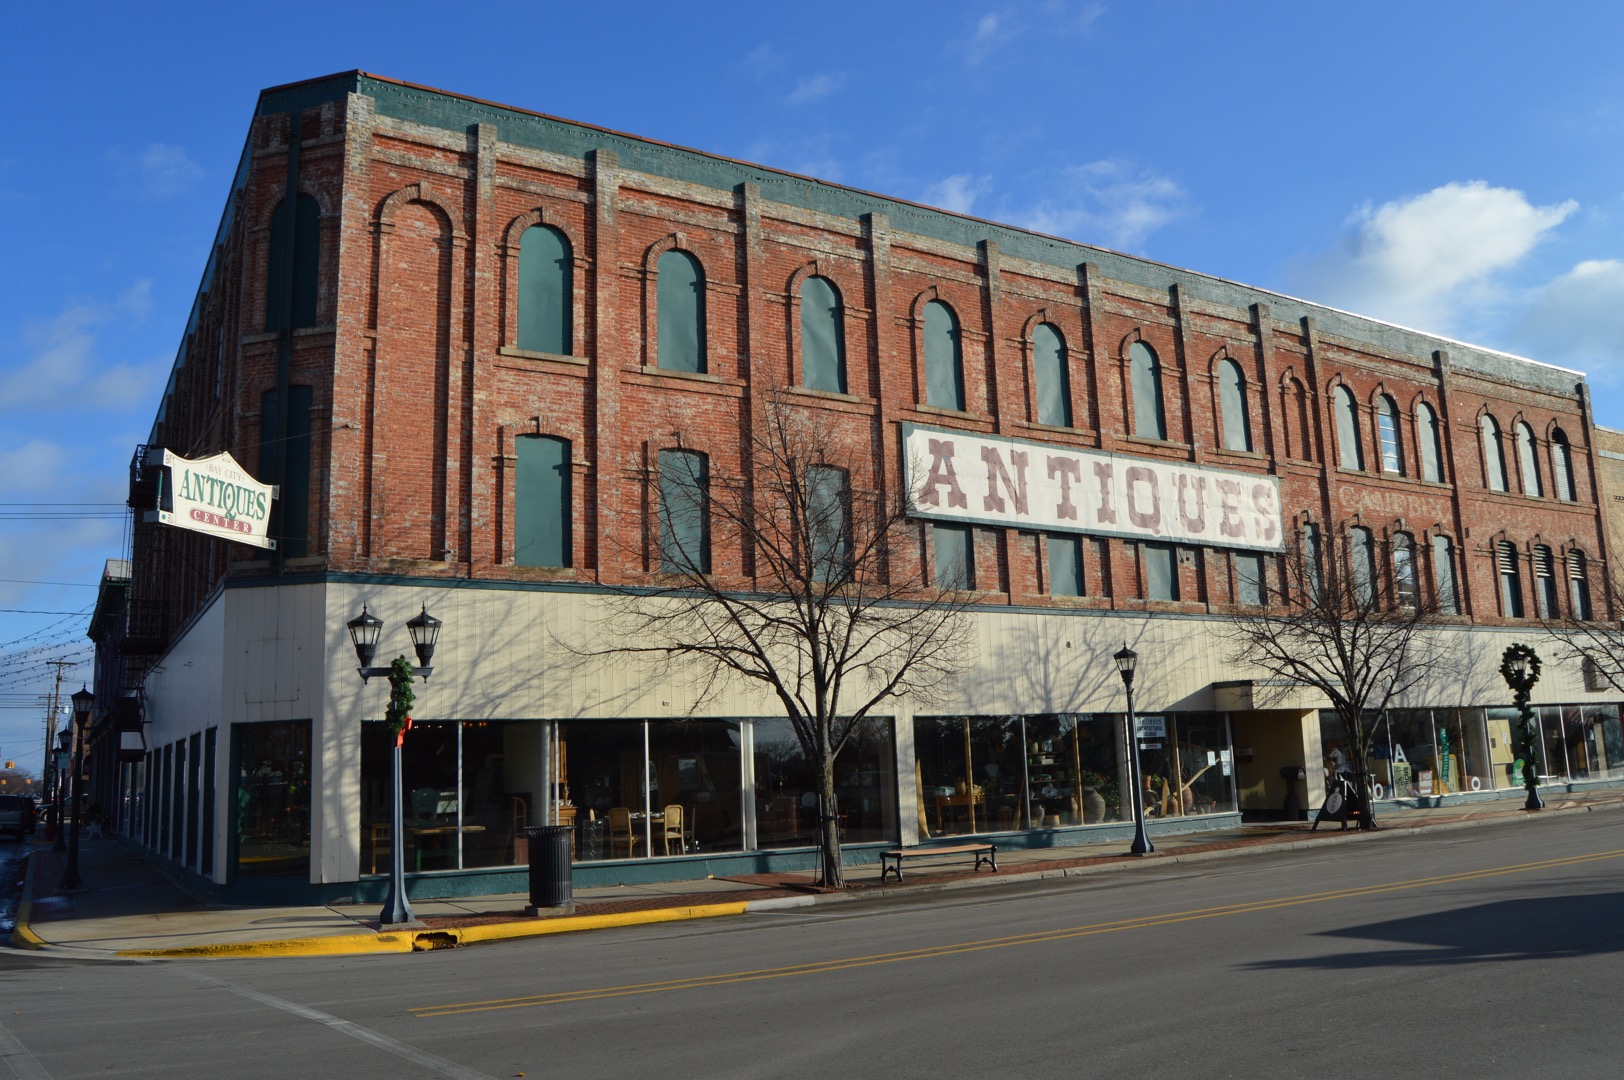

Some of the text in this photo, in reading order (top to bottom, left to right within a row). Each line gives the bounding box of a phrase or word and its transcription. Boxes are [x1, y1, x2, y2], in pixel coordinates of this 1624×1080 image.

[208, 463, 242, 481] BAY CITY
[917, 438, 1277, 542] ANTIQUES
[178, 468, 266, 521] ANTIQUES
[193, 510, 249, 533] CENTER
